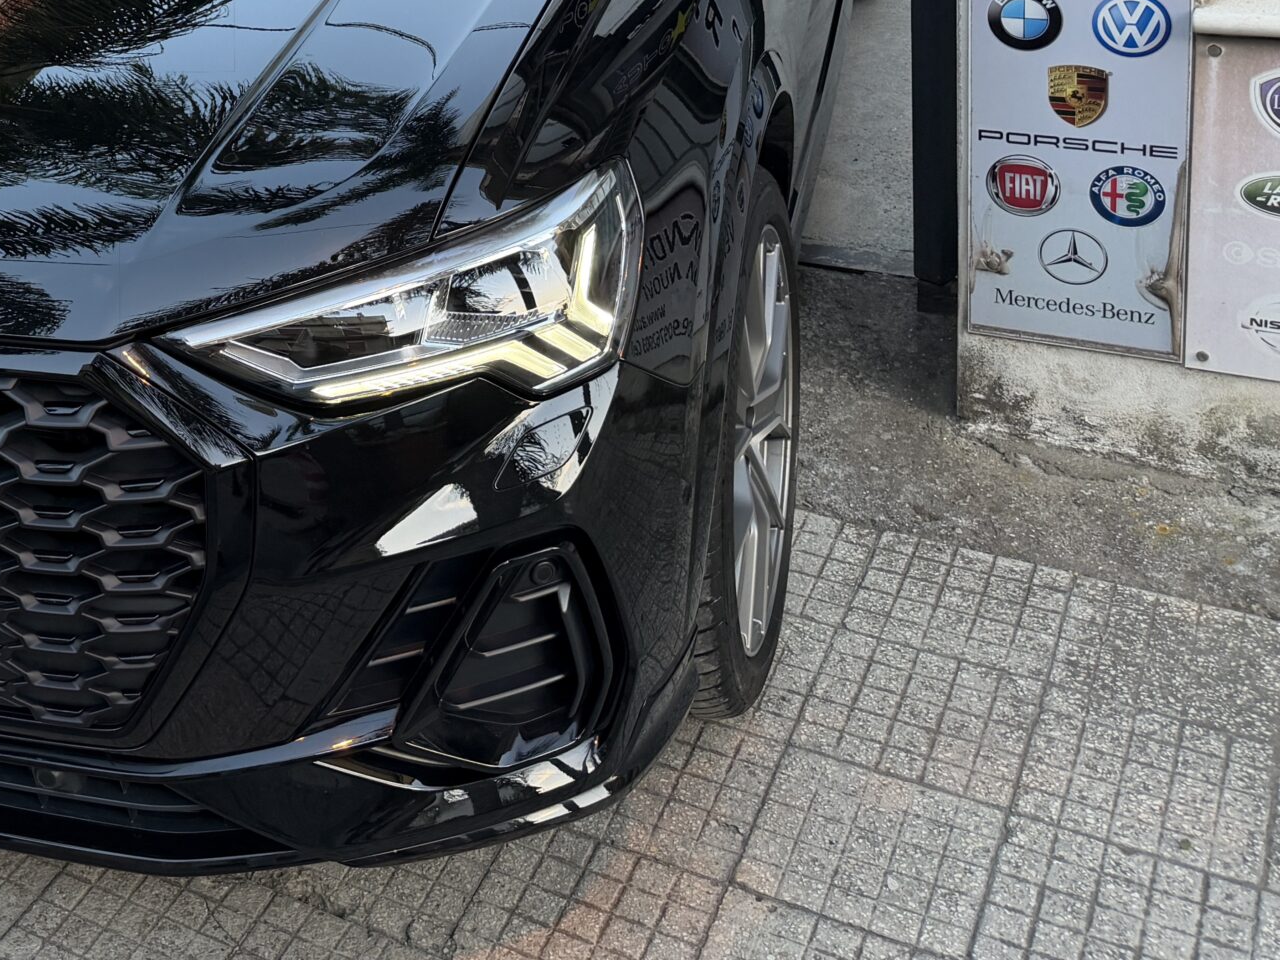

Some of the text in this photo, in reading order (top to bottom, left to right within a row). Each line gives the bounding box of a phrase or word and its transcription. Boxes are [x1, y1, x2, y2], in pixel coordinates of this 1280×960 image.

[978, 129, 1178, 159] PORSCHE
[1005, 172, 1044, 200] FIAT
[1092, 167, 1164, 202] ALFA ROMEO
[994, 288, 1156, 325] Mercedes-Benz
